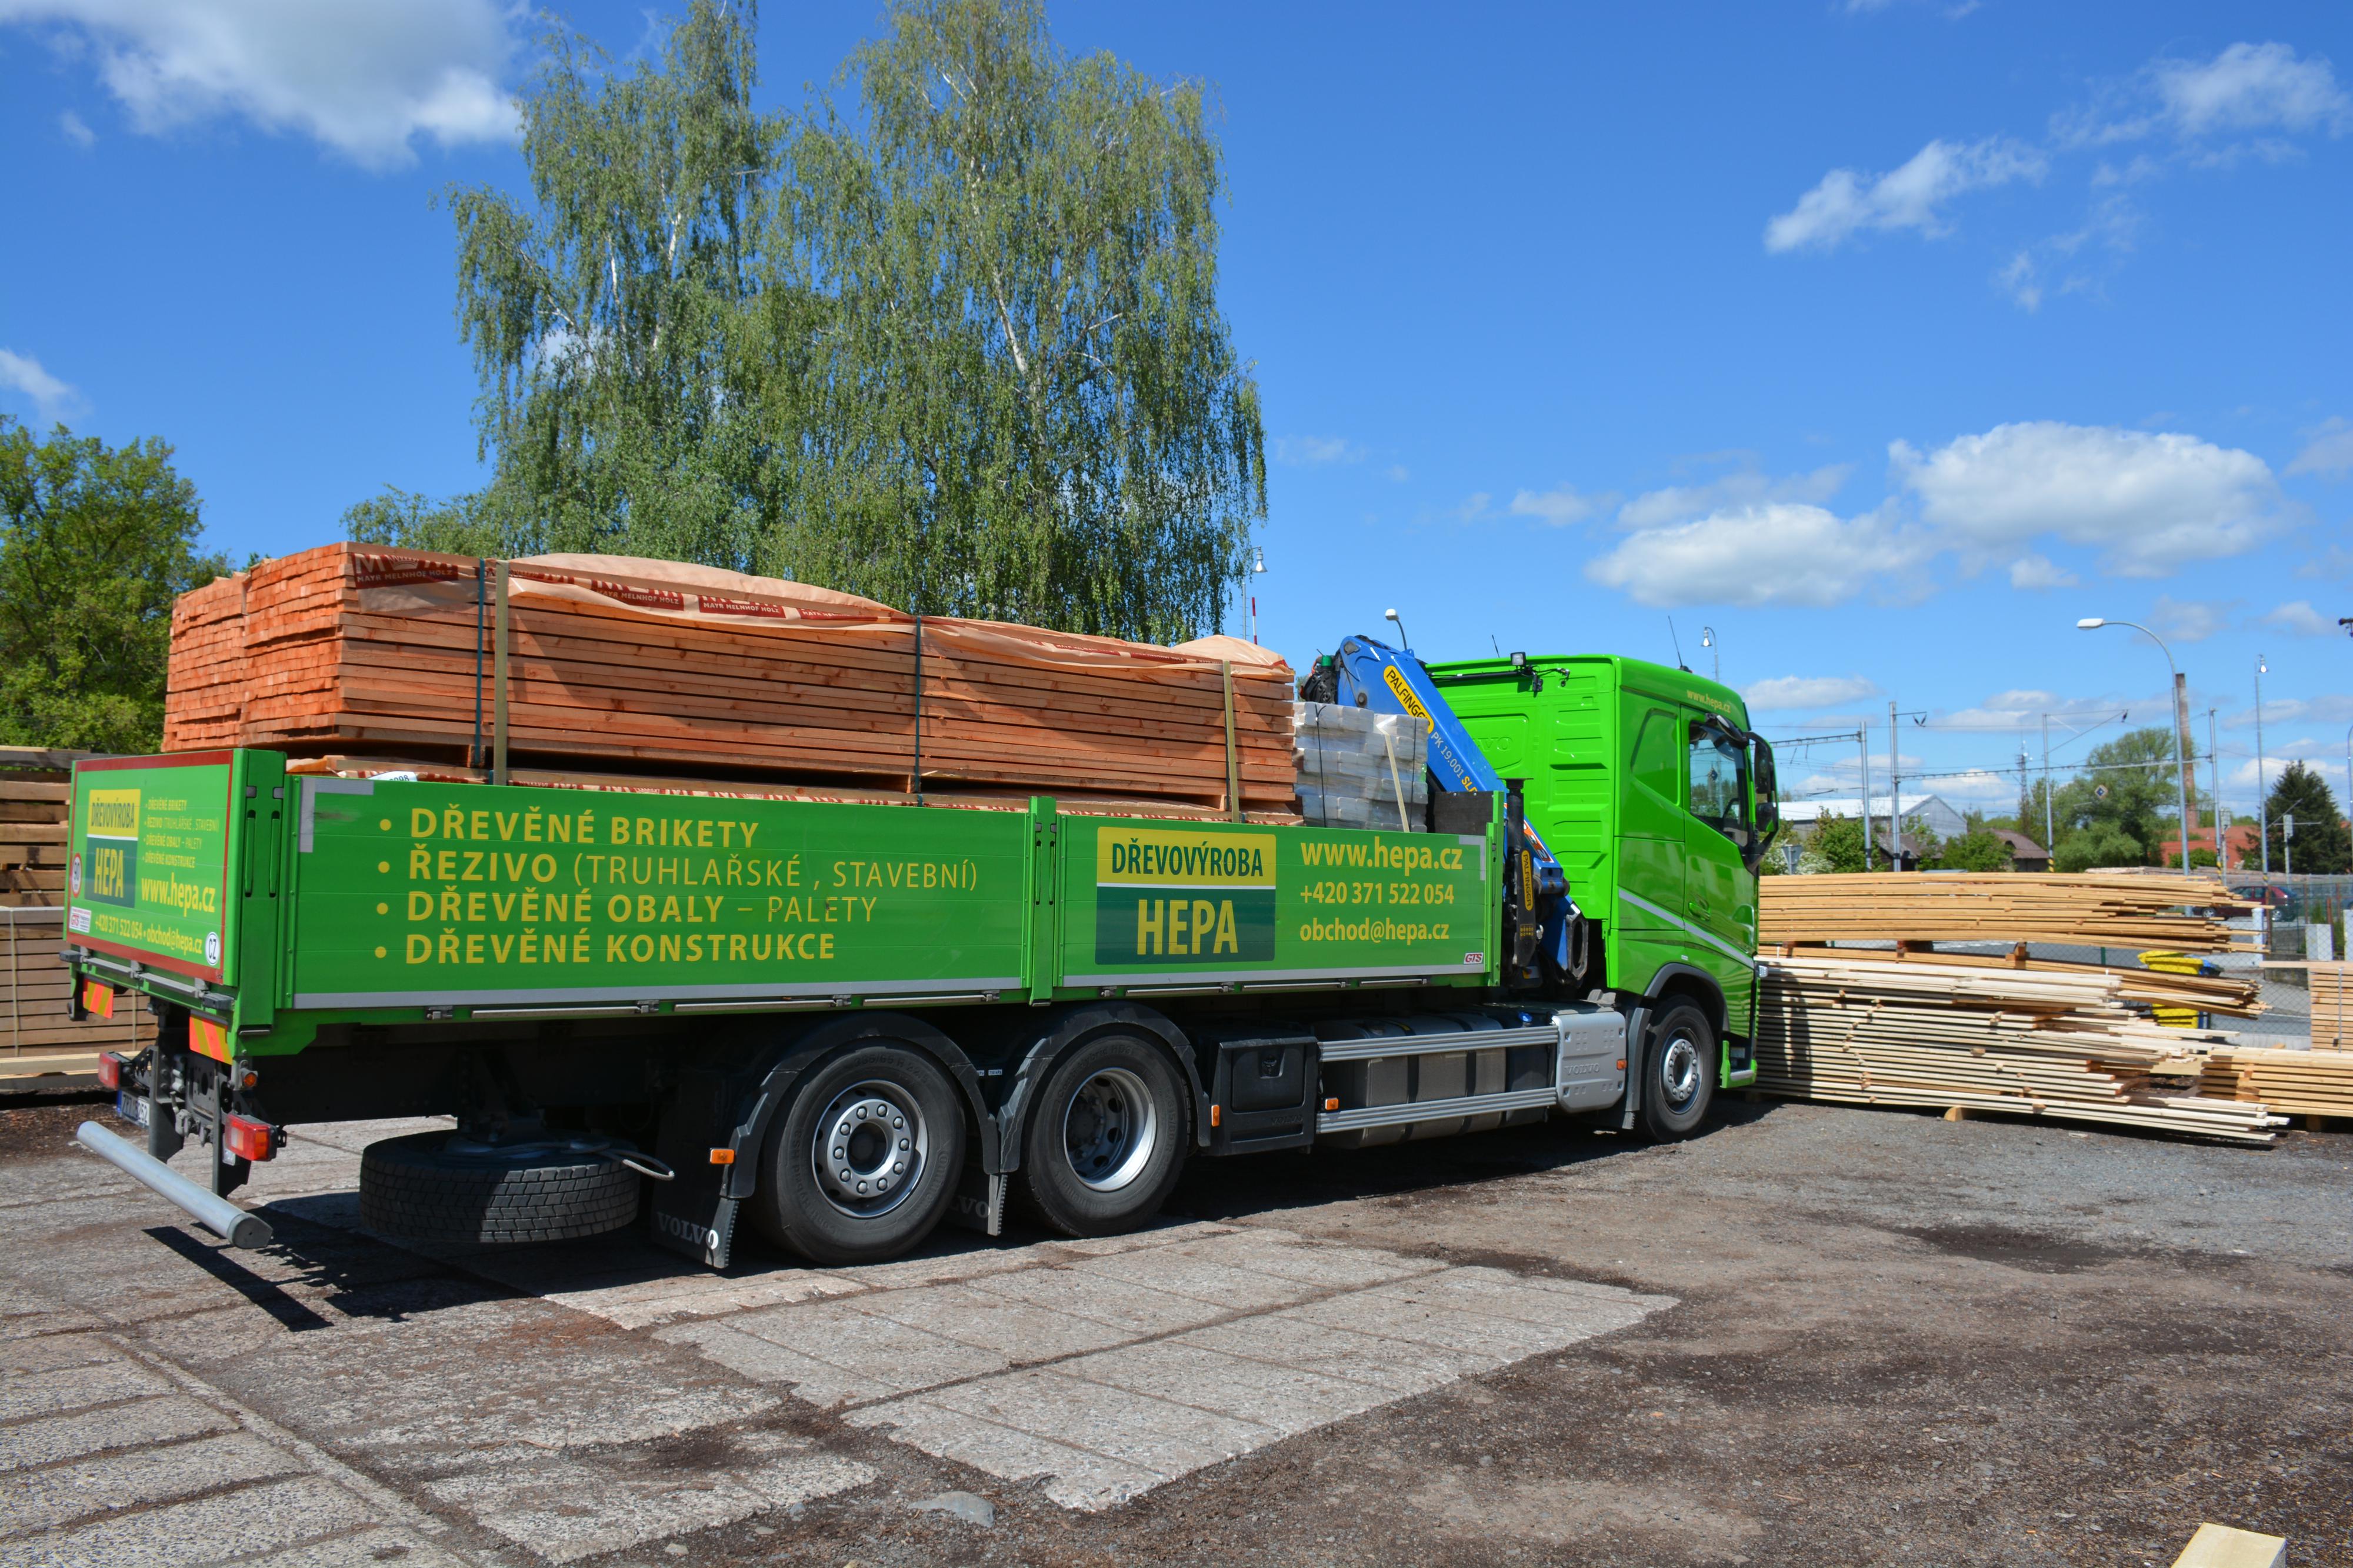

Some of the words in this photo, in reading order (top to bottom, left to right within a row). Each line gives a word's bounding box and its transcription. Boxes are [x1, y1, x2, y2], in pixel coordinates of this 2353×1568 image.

[357, 574, 382, 583] MAYR
[384, 571, 426, 581] MELNHOF
[621, 592, 658, 602] MELNHOF
[659, 596, 680, 605] HOLZ
[726, 603, 760, 612] MELNHOF
[761, 605, 781, 613] HOLZ
[1687, 689, 1731, 713] www.hepa.cz
[1431, 731, 1444, 749] PK
[1440, 745, 1465, 778] 19.001
[91, 797, 135, 828] DŘEVOVÝROBA
[411, 803, 595, 844] DŘEVĚNÉ
[611, 816, 759, 848] BRIKETY
[94, 847, 124, 898] HEPA
[409, 843, 558, 883] ŘEZIVO
[1111, 837, 1264, 878] DŘEVOVÝROBA
[1300, 835, 1464, 877] www.hepa.cz
[141, 872, 216, 918] www.hepa.cz
[1300, 882, 1348, 905] +420
[1352, 882, 1383, 905] 371
[1389, 883, 1421, 905] 522
[1424, 883, 1455, 905] 054
[1523, 855, 1532, 907] PALFINGER
[407, 885, 592, 923] DŘEVĚNÉ
[606, 894, 725, 923] OBALY
[768, 895, 878, 923] PALETY
[119, 918, 131, 937] 522
[131, 920, 143, 940] 054
[146, 923, 203, 956] obchod@hepa.cz
[405, 928, 591, 965] DŘEVĚNÉ
[606, 933, 835, 963] KONSTRUKCE
[1137, 899, 1239, 956] HEPA
[1299, 917, 1451, 946] obchod@hepa.cz
[208, 938, 217, 960] CZ
[1465, 953, 1482, 963] GTS
[1564, 1063, 1601, 1076] VOLVO
[656, 1211, 719, 1250] VOLVO
